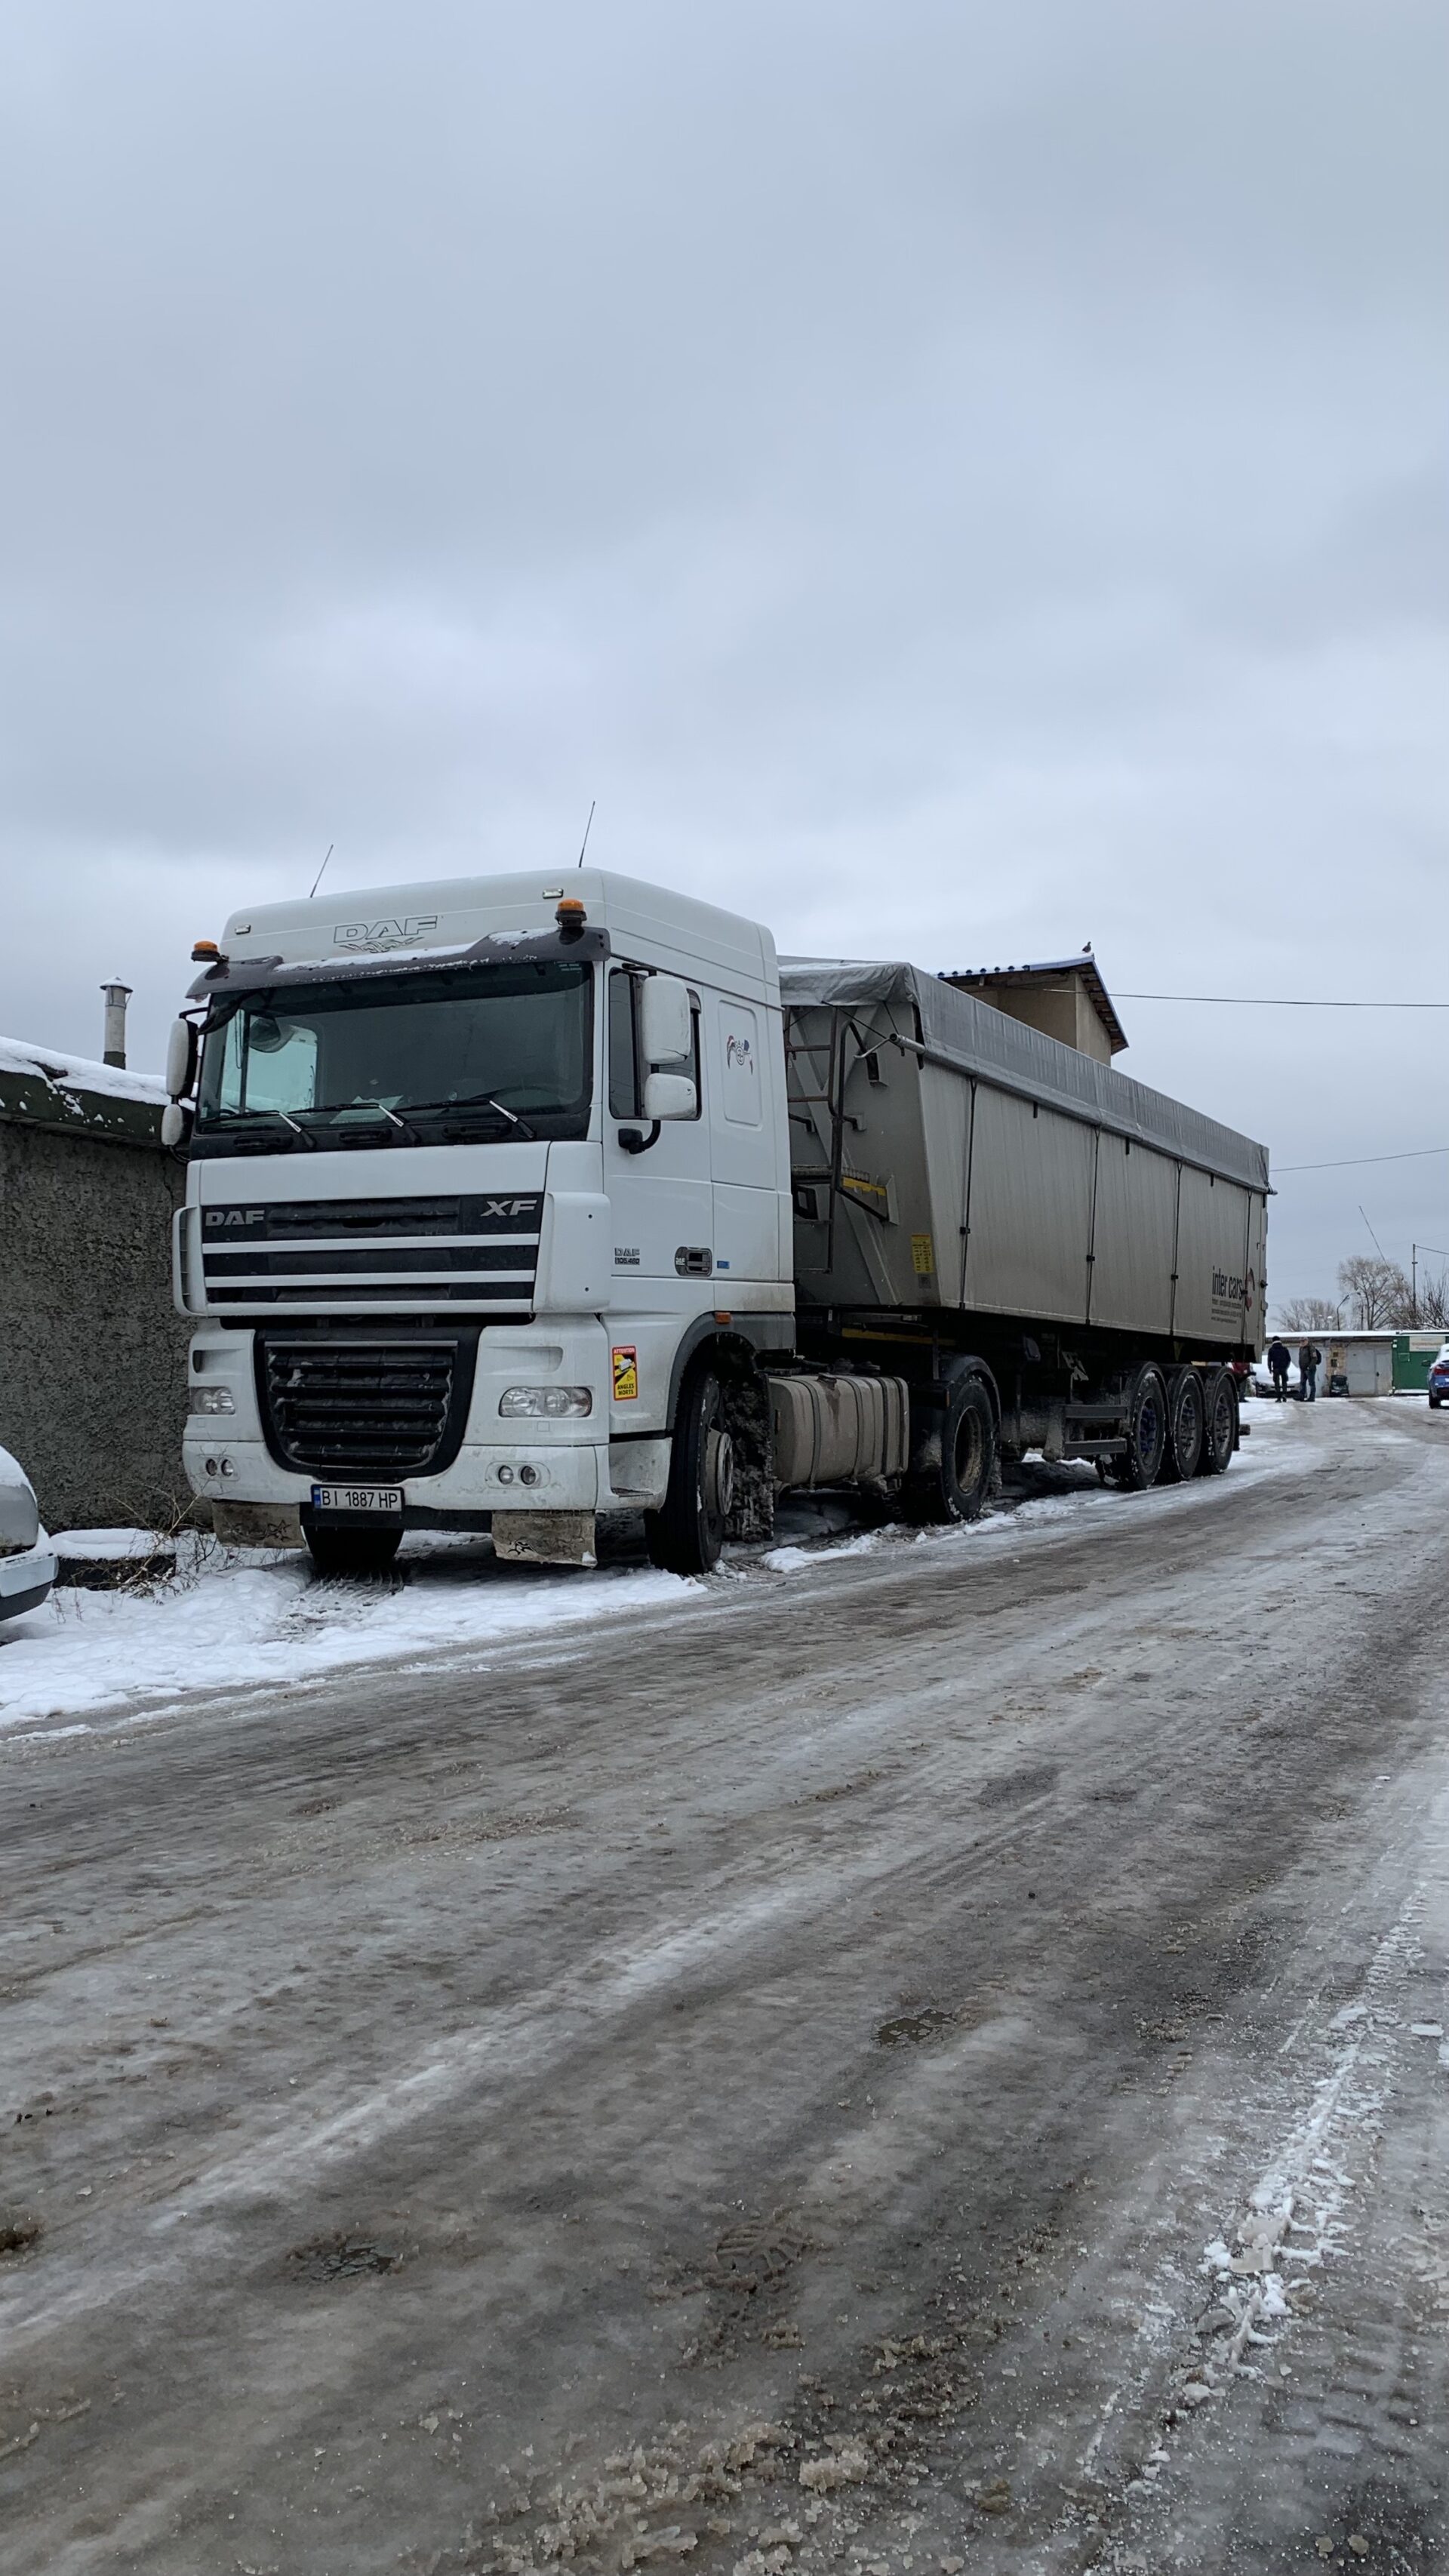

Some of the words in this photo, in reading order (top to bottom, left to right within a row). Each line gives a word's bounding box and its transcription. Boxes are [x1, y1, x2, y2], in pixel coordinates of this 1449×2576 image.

[334, 916, 438, 943] DAF
[481, 1200, 537, 1217] XF
[205, 1211, 265, 1226] DAF
[614, 1248, 640, 1257] DAF
[1212, 1265, 1227, 1297] inter
[1228, 1276, 1243, 1300] cars
[321, 1490, 338, 1507] BI
[345, 1491, 375, 1508] 1887
[378, 1492, 398, 1509] HP
